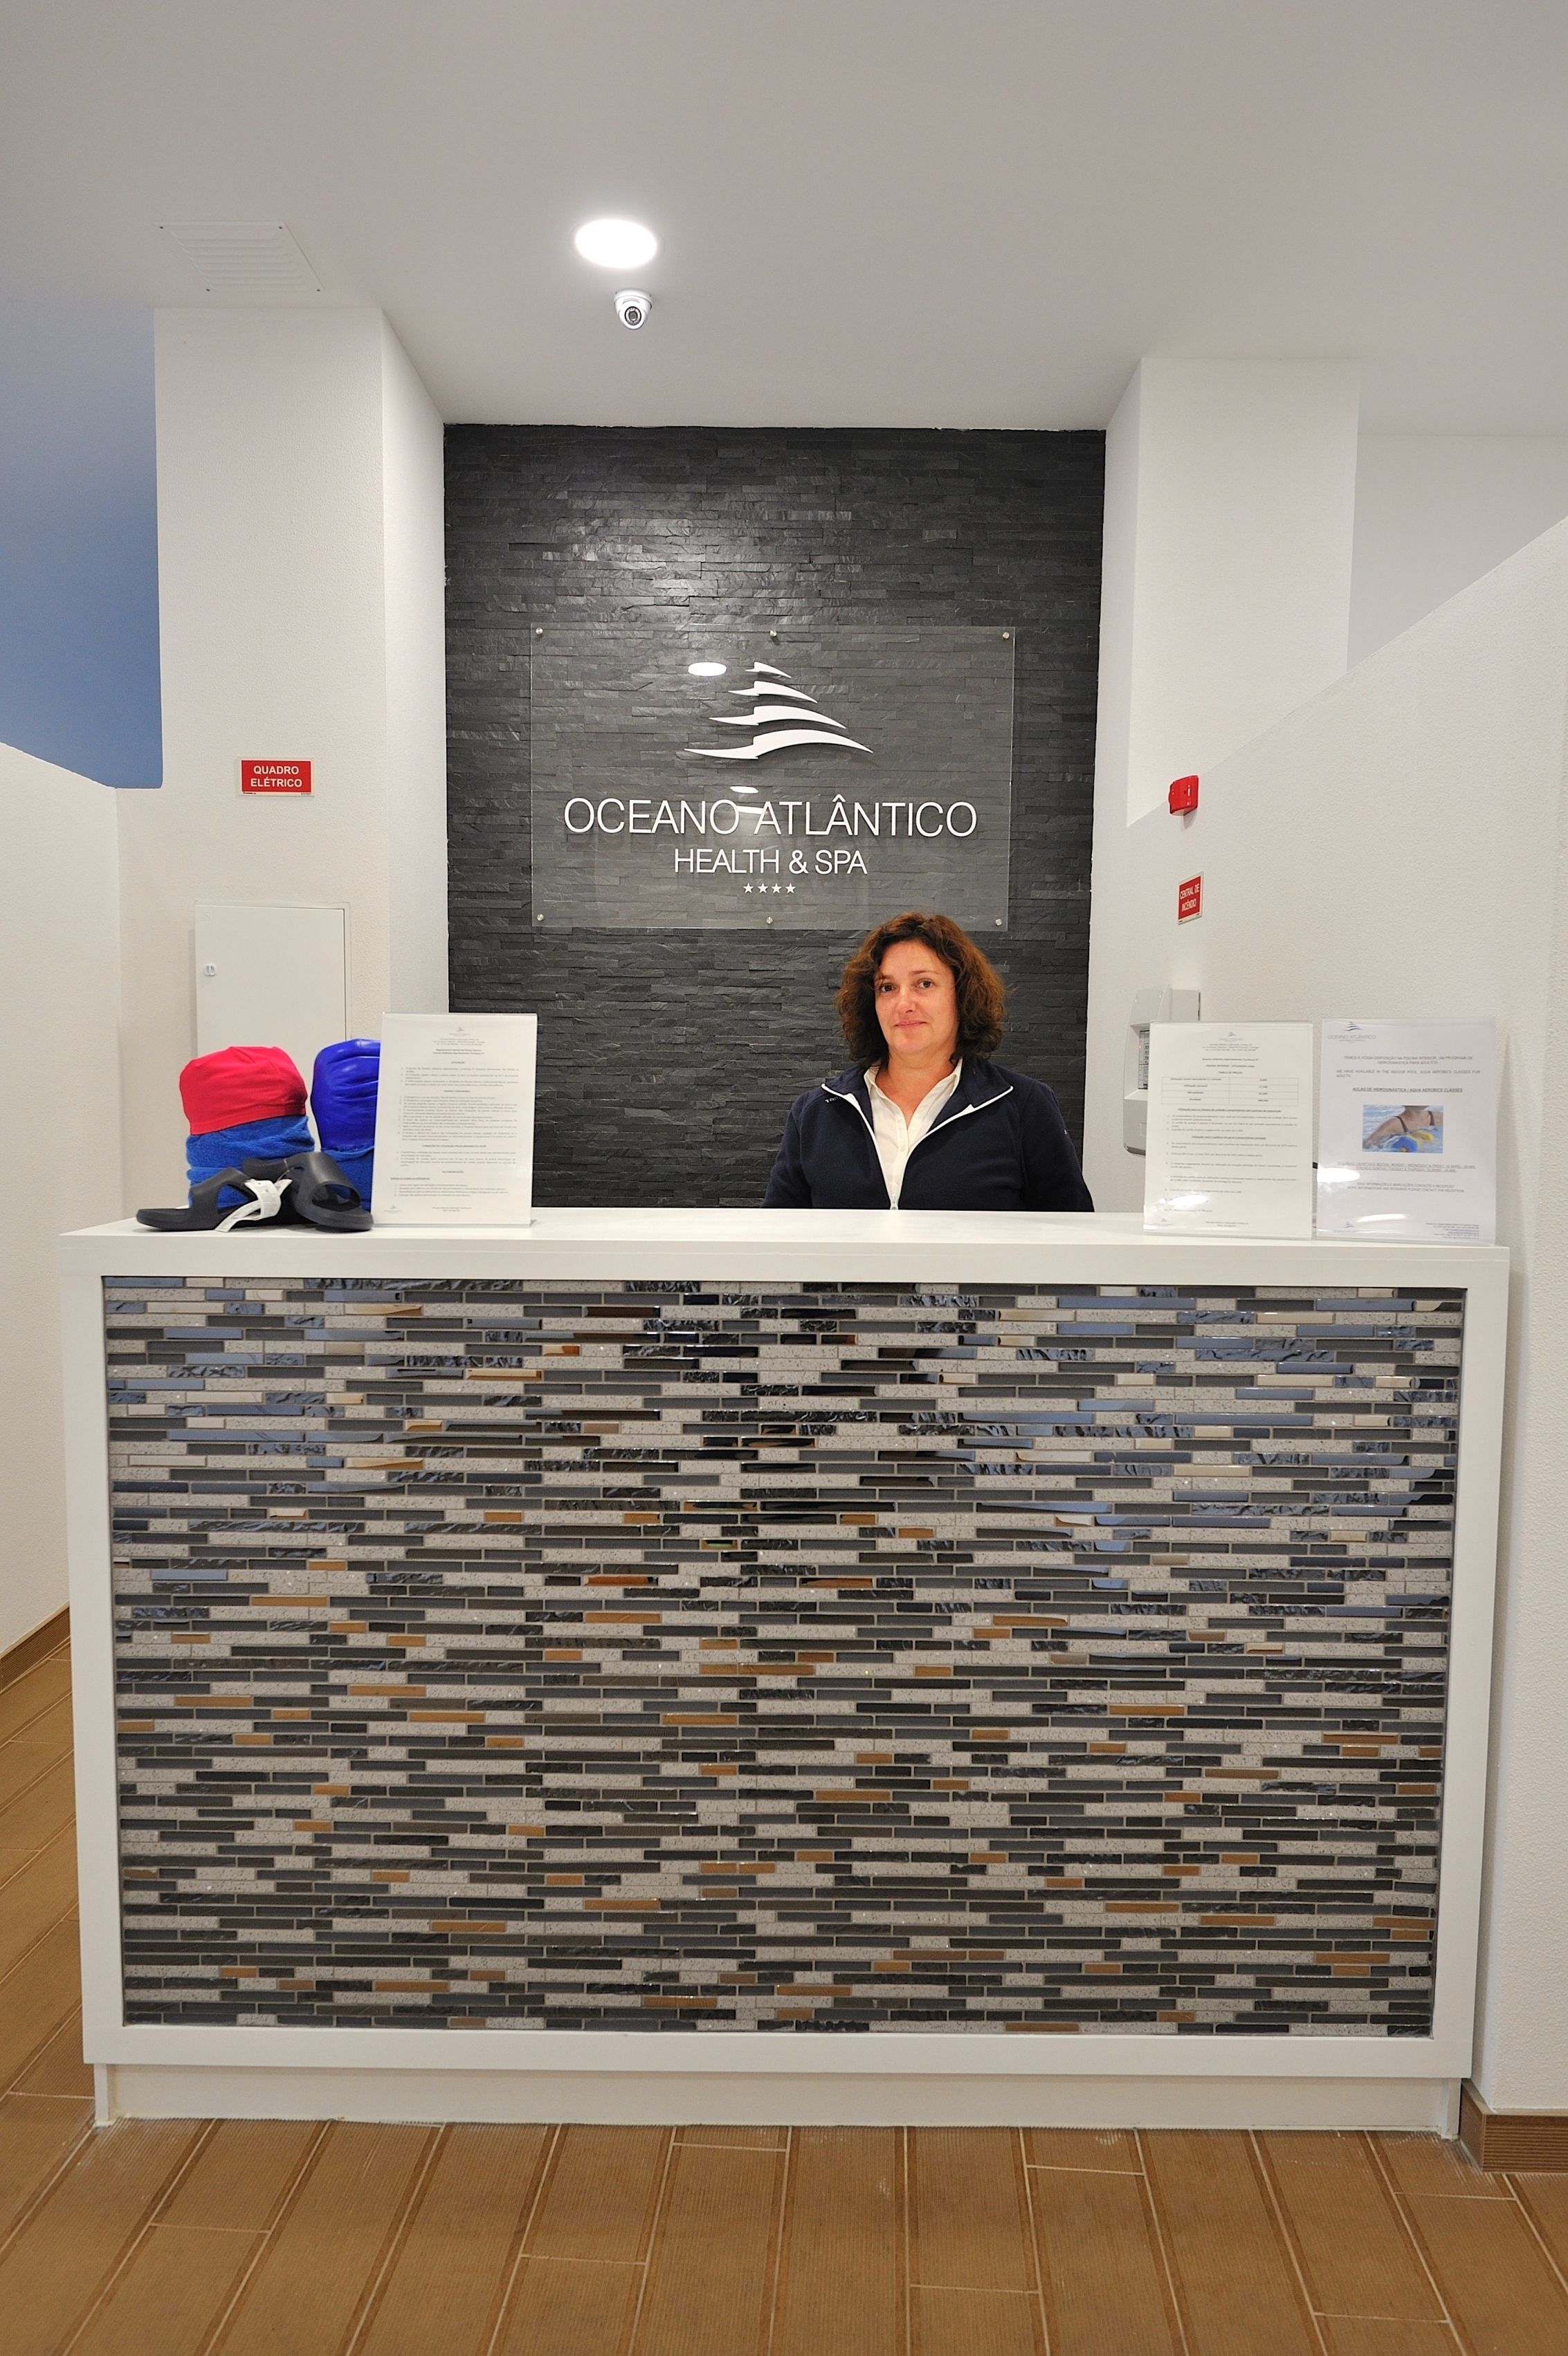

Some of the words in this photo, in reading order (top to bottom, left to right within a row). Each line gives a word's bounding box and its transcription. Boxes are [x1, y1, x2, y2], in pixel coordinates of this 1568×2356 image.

[253, 765, 299, 774] QUADRO
[250, 776, 302, 787] ELÉTRICO
[564, 798, 739, 834] OCEANO
[754, 794, 978, 837] ATLÂNTICO
[675, 848, 778, 874] HEALTH
[789, 849, 808, 874] &
[815, 849, 867, 875] SPA
[1180, 887, 1194, 900] CENTRAL
[1194, 883, 1200, 894] DE
[1182, 898, 1196, 912] INCÊNDIO
